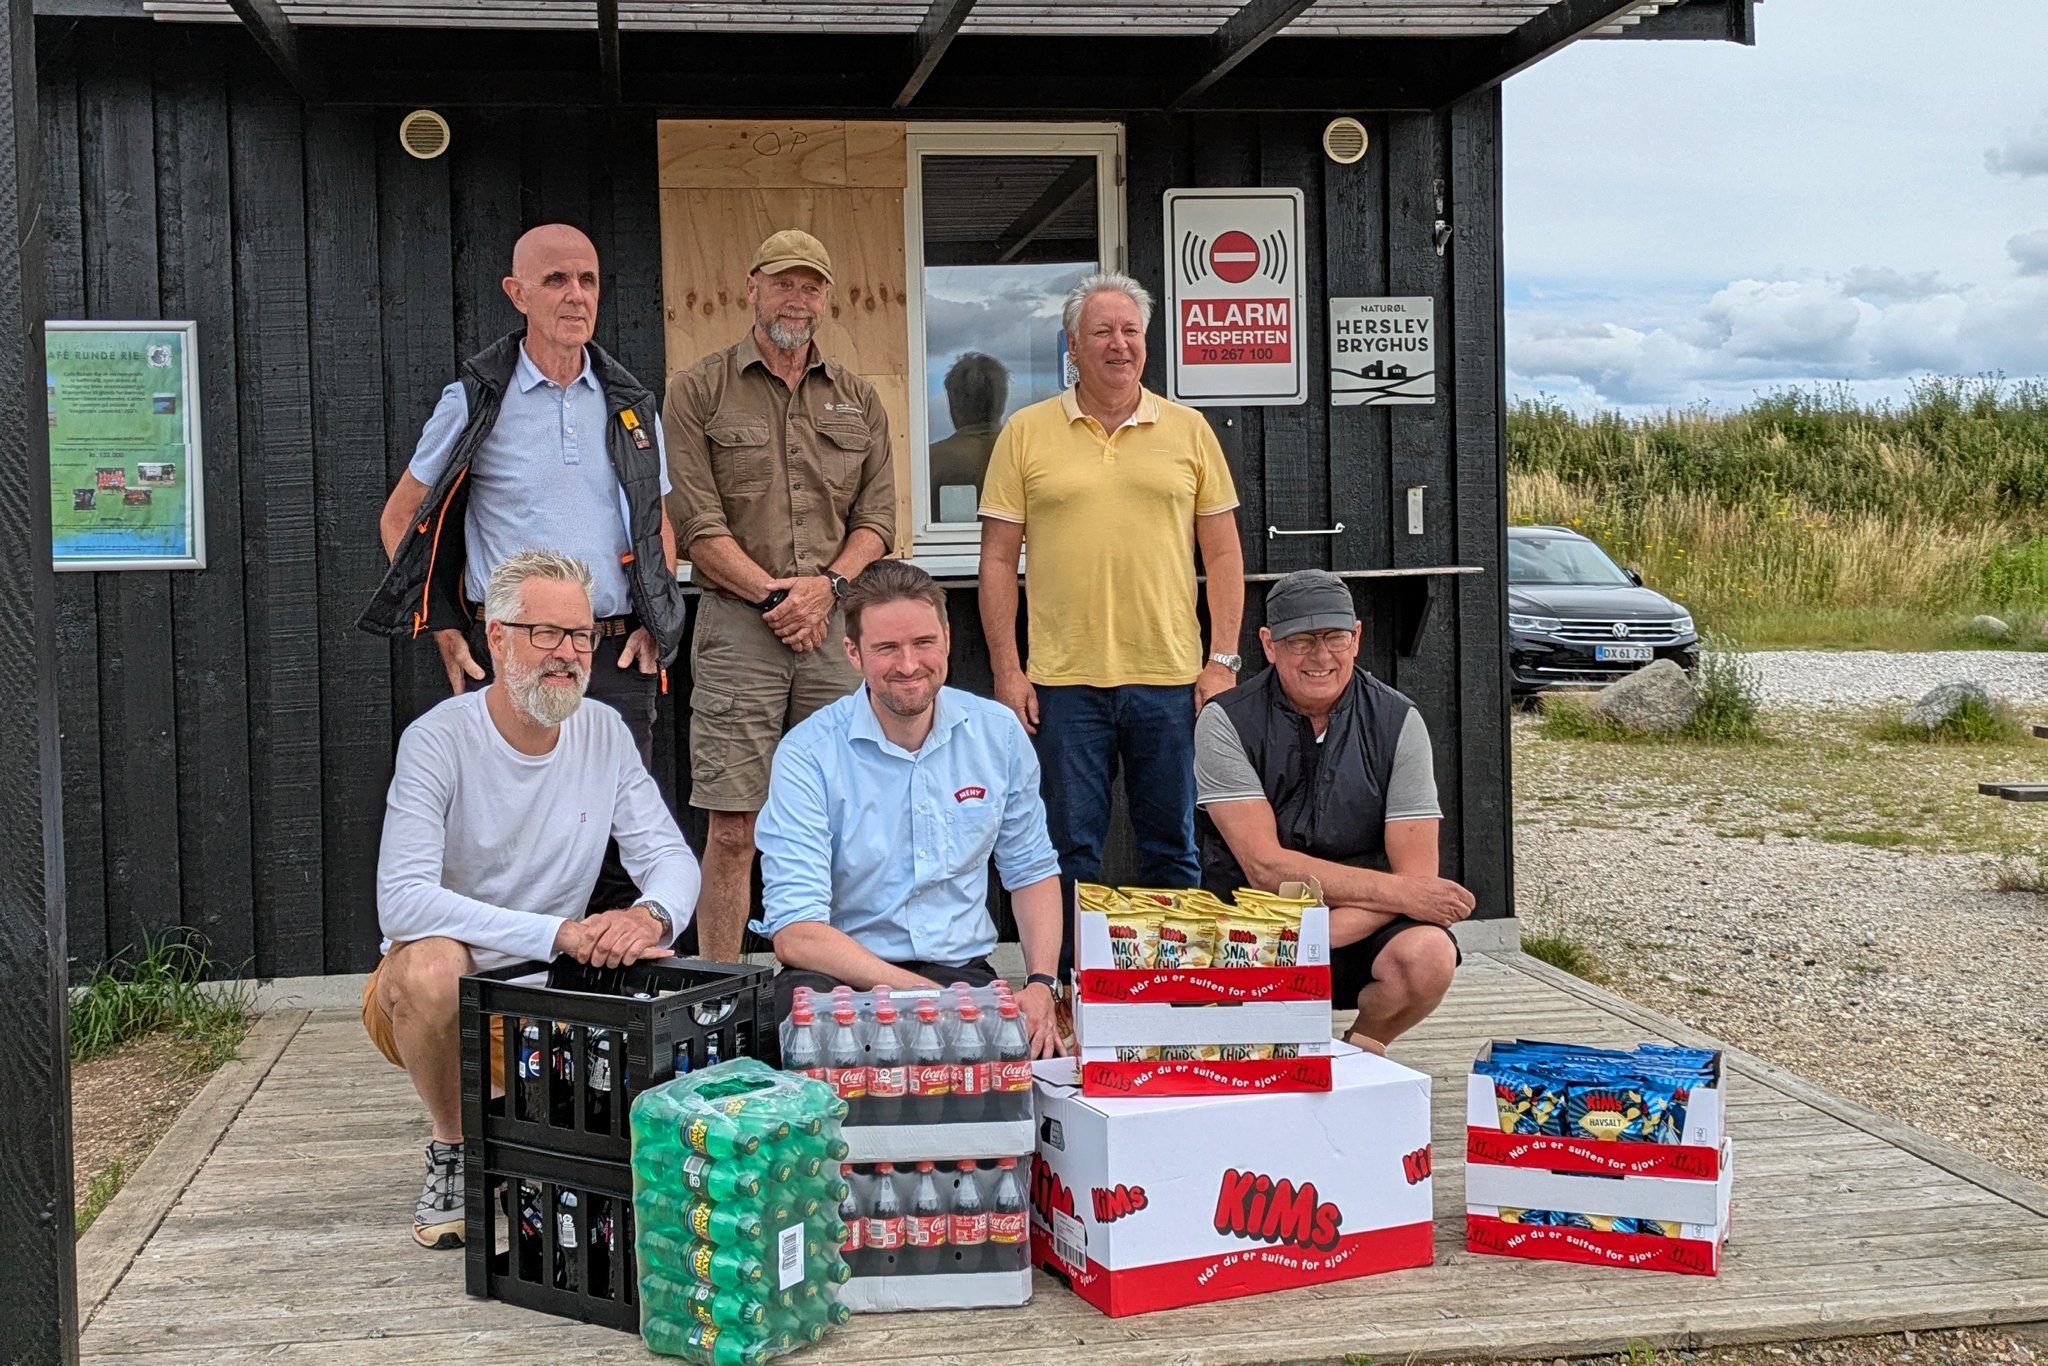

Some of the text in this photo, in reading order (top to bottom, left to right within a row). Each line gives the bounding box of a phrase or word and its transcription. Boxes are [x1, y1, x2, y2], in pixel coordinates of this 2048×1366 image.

[1186, 303, 1288, 328] ALARM
[1360, 304, 1407, 314] NATURØL
[1336, 319, 1430, 335] HERSLEV
[1186, 330, 1288, 346] EKSPERTEN
[1337, 337, 1429, 353] BRYGHUS
[48, 350, 140, 360] AFÉ RUNDE RIE
[1201, 347, 1273, 361] 70 267 100
[1604, 647, 1651, 659] DX 61 733
[1112, 940, 1140, 957] NACK
[1115, 957, 1140, 969] HIPS
[1129, 979, 1150, 996] Når
[1153, 974, 1168, 984] du
[1172, 974, 1185, 982] er
[1189, 976, 1225, 993] sulten
[1228, 986, 1246, 997] for
[1117, 1049, 1141, 1062] HIPS
[1133, 1070, 1153, 1087] Når
[1157, 1065, 1172, 1075] du
[1175, 1064, 1189, 1073] er
[1193, 1066, 1228, 1084] sulten
[1231, 1077, 1250, 1088] for
[1589, 1118, 1622, 1128] HAVSALT
[1509, 1144, 1529, 1159] Når
[1532, 1140, 1547, 1149] du
[1550, 1140, 1564, 1149] er
[1568, 1144, 1604, 1164] sulten
[1607, 1158, 1626, 1170] for
[1507, 1234, 1527, 1248] Når
[1530, 1230, 1545, 1239] du
[1548, 1230, 1562, 1238] er
[1566, 1235, 1602, 1255] sulten
[1605, 1249, 1624, 1261] for
[1067, 1264, 1078, 1279] for
[1198, 1263, 1219, 1286] Når
[1223, 1254, 1238, 1267] du
[1243, 1252, 1256, 1261] er
[1261, 1252, 1298, 1269] sulten
[1301, 1258, 1320, 1270] for
